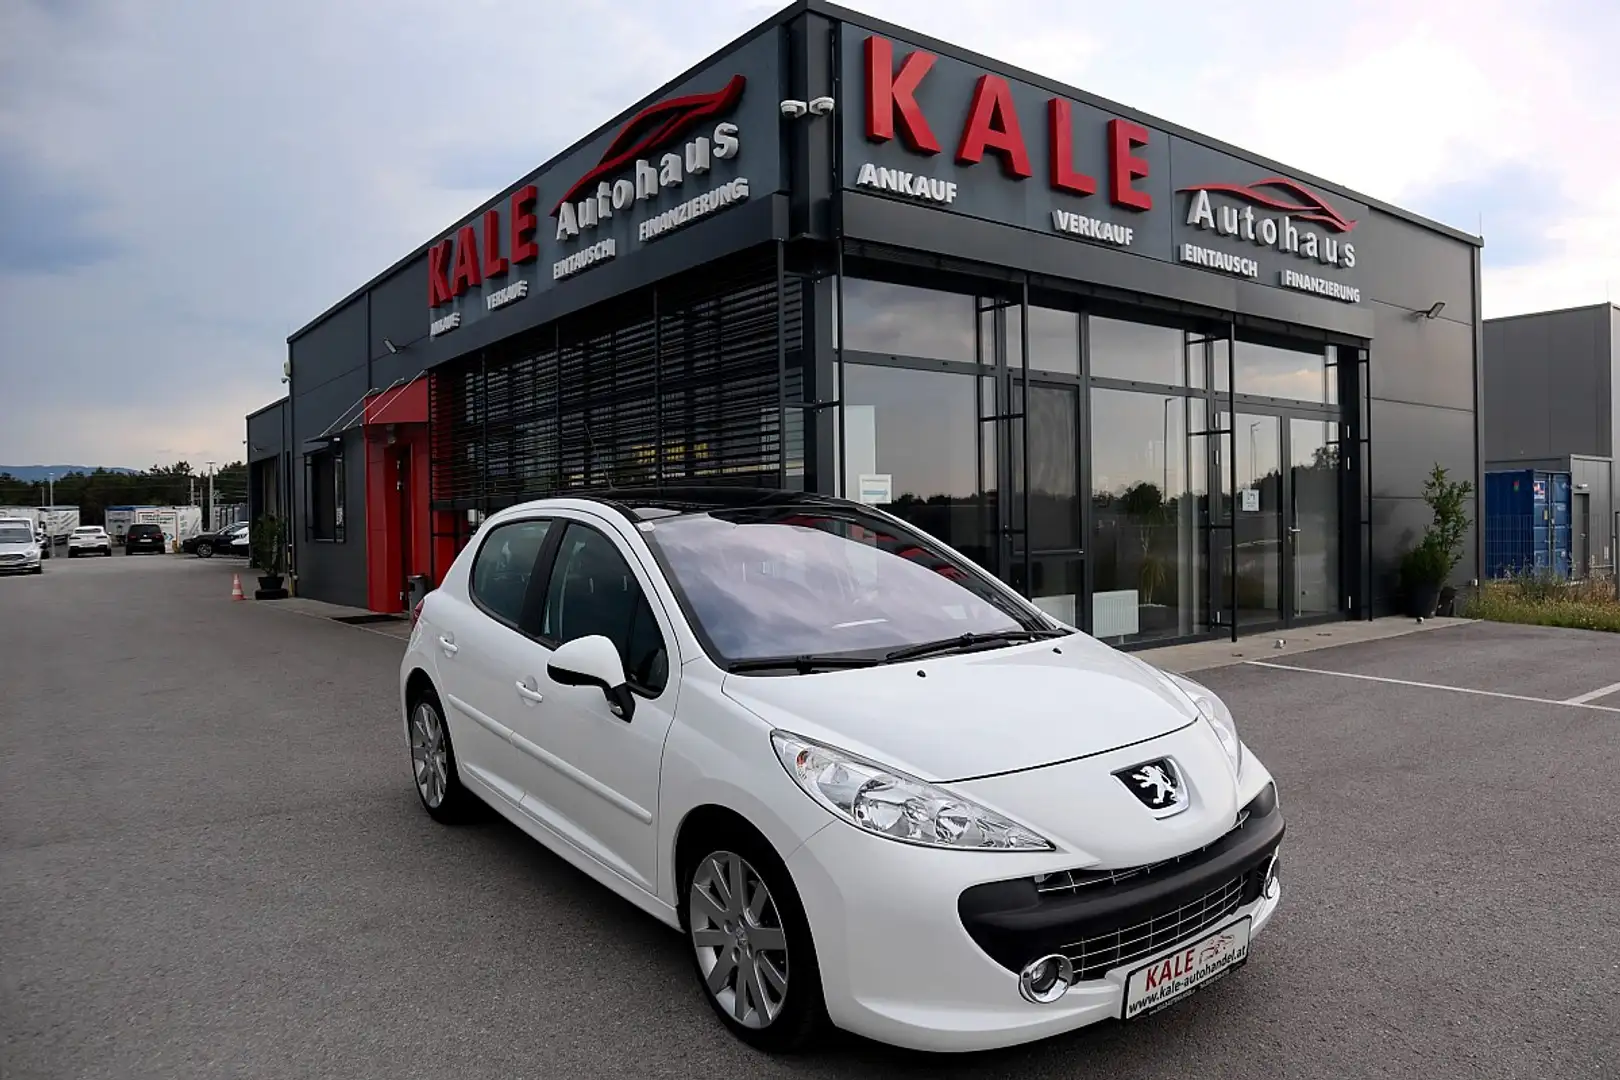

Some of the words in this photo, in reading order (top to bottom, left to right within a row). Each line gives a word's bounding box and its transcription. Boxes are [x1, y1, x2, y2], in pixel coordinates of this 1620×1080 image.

[864, 36, 1152, 212] KALE
[1187, 190, 1355, 267] Autohaus
[428, 185, 538, 308] KALE
[556, 122, 739, 240] Autohaus
[553, 238, 616, 280] EINTAUSCH
[639, 177, 749, 242] FINANZIERUNG
[856, 163, 957, 203] ANKAUF
[1052, 209, 1133, 245] VERKAUF
[1180, 243, 1258, 277] EINTAUSCH
[1281, 270, 1360, 302] FINANZIERUNG
[1128, 945, 1246, 1014] www.kale-autohandel.at
[1145, 949, 1195, 992] KALE
